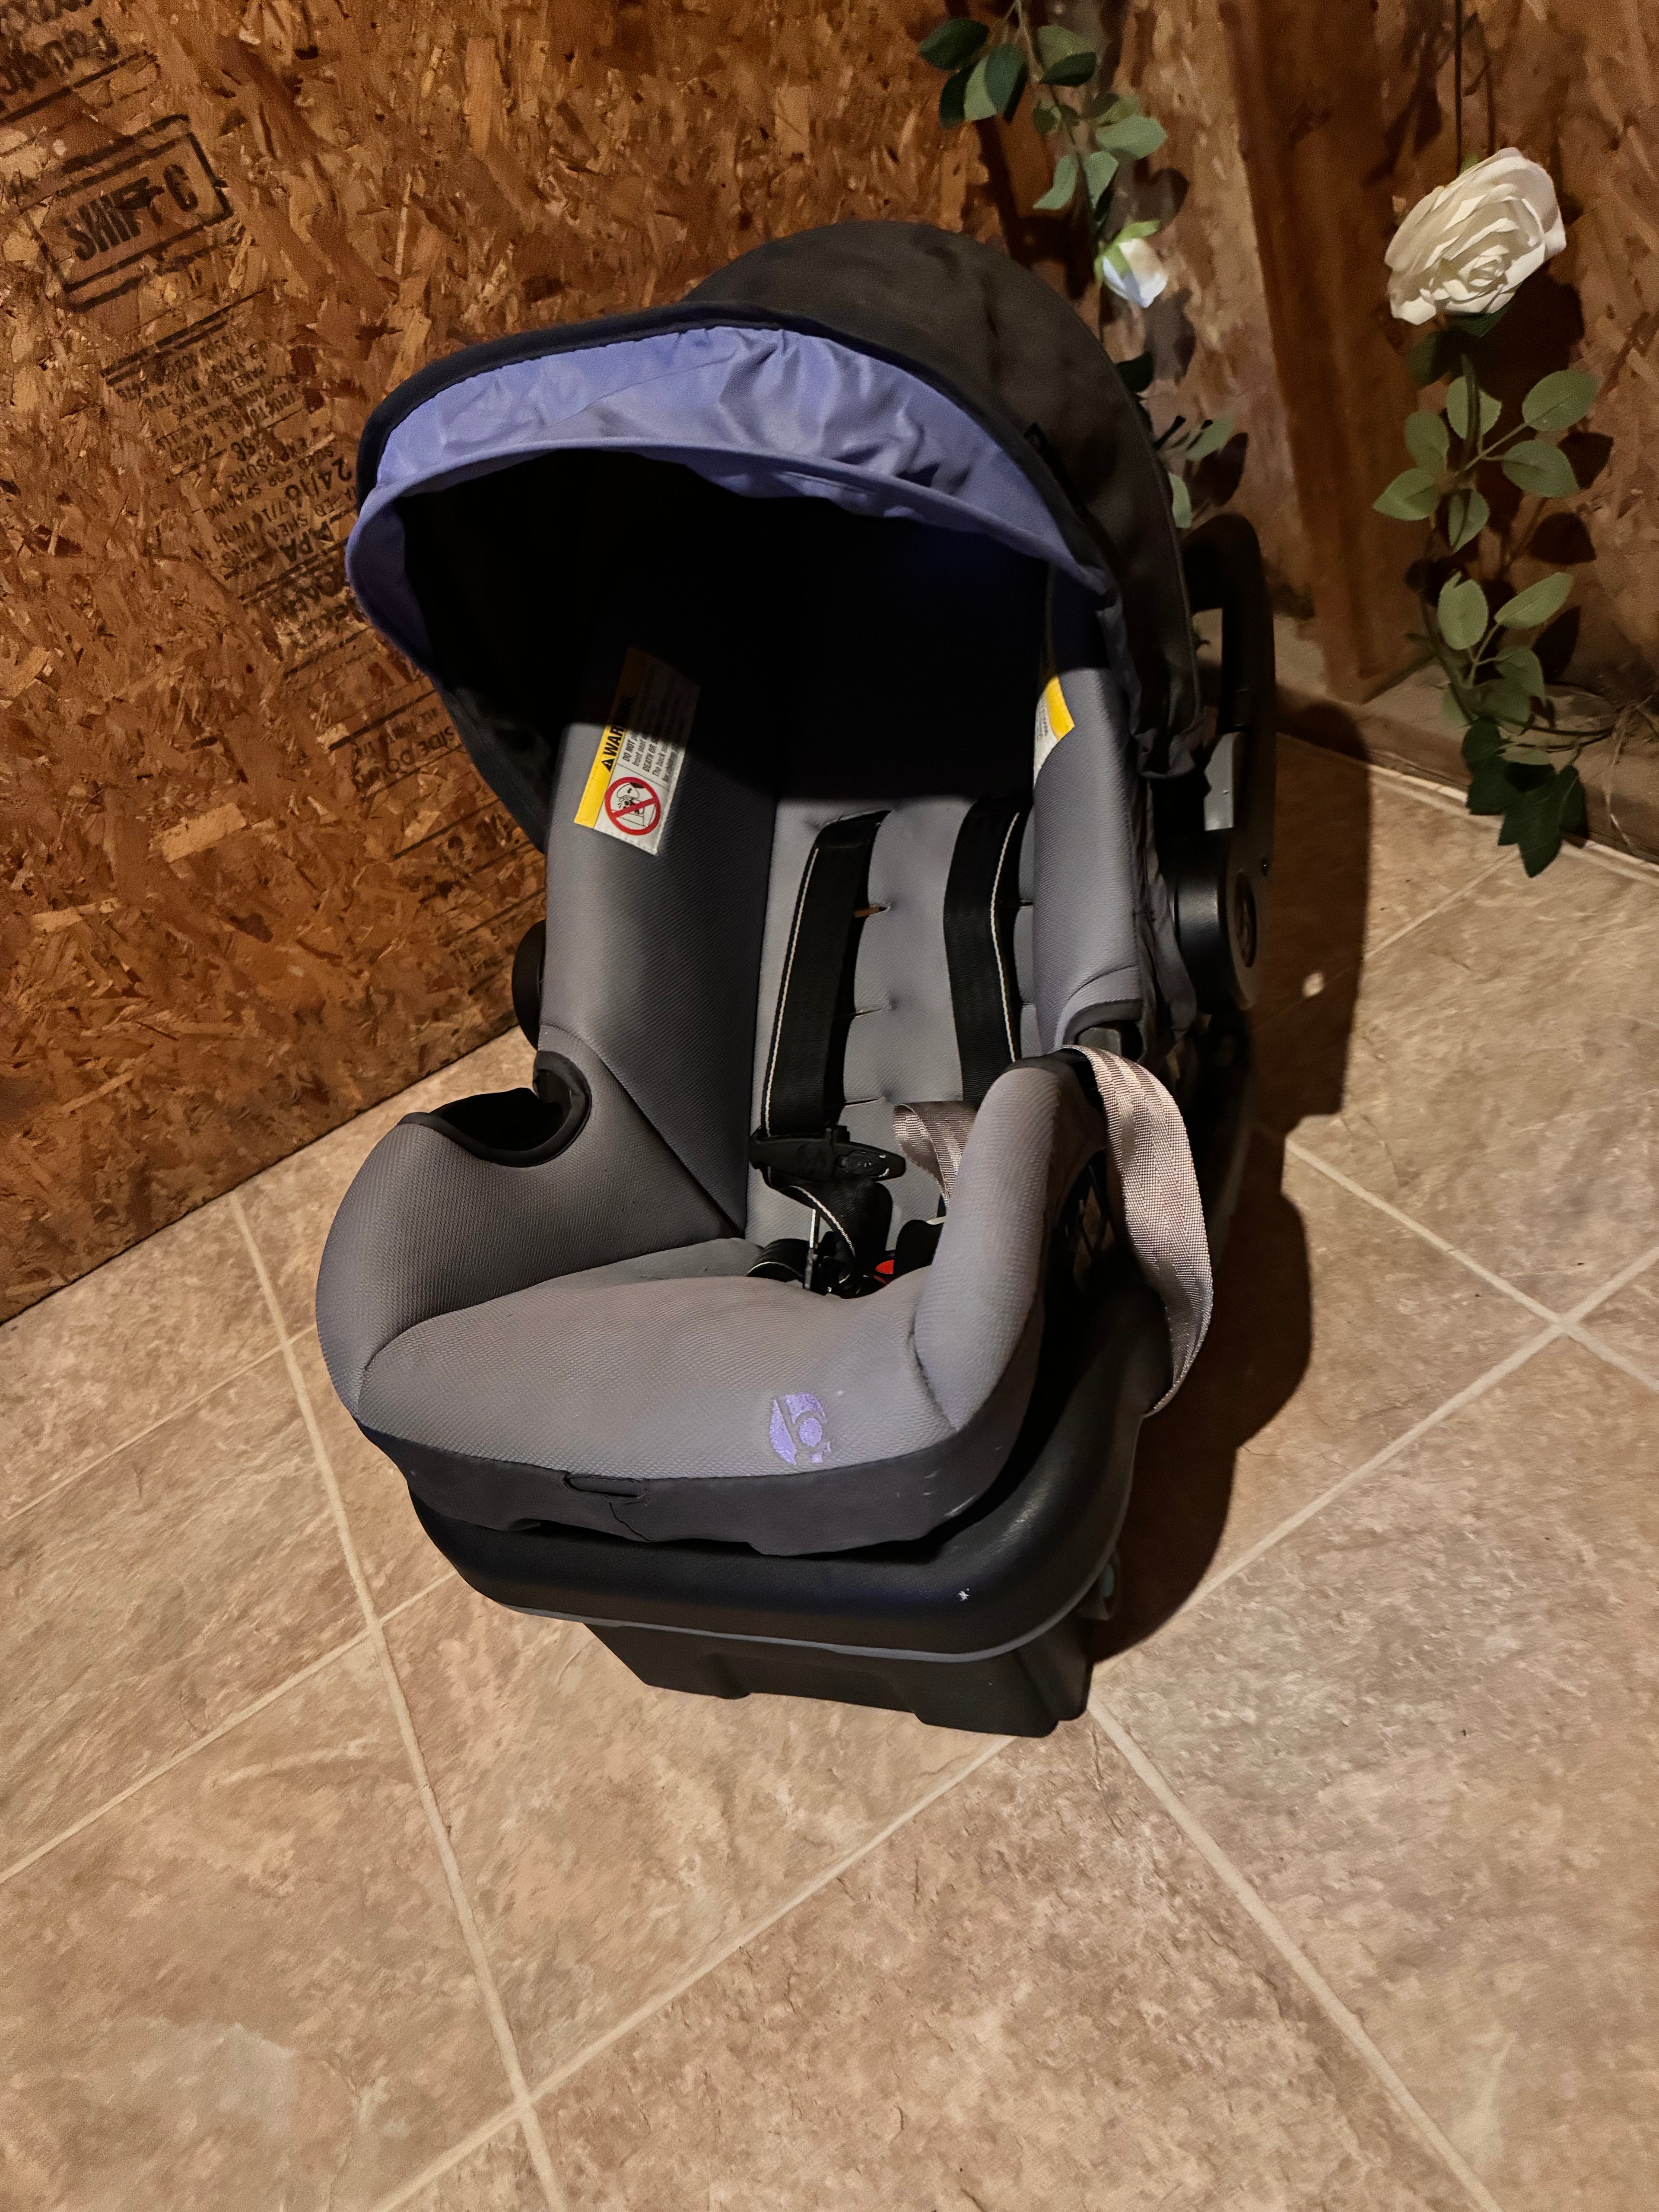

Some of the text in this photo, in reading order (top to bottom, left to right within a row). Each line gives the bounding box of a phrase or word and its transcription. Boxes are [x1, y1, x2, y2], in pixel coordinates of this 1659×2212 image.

[266, 466, 295, 488] FOR
[282, 457, 355, 511] 24/16
[415, 725, 458, 758] SIDE
[636, 738, 647, 753] seat
[648, 744, 657, 753] OR
[622, 739, 636, 762] DO NOT
[632, 751, 643, 766] front
[642, 753, 655, 772] DEATH
[655, 753, 665, 766] back
[652, 766, 661, 777] The
